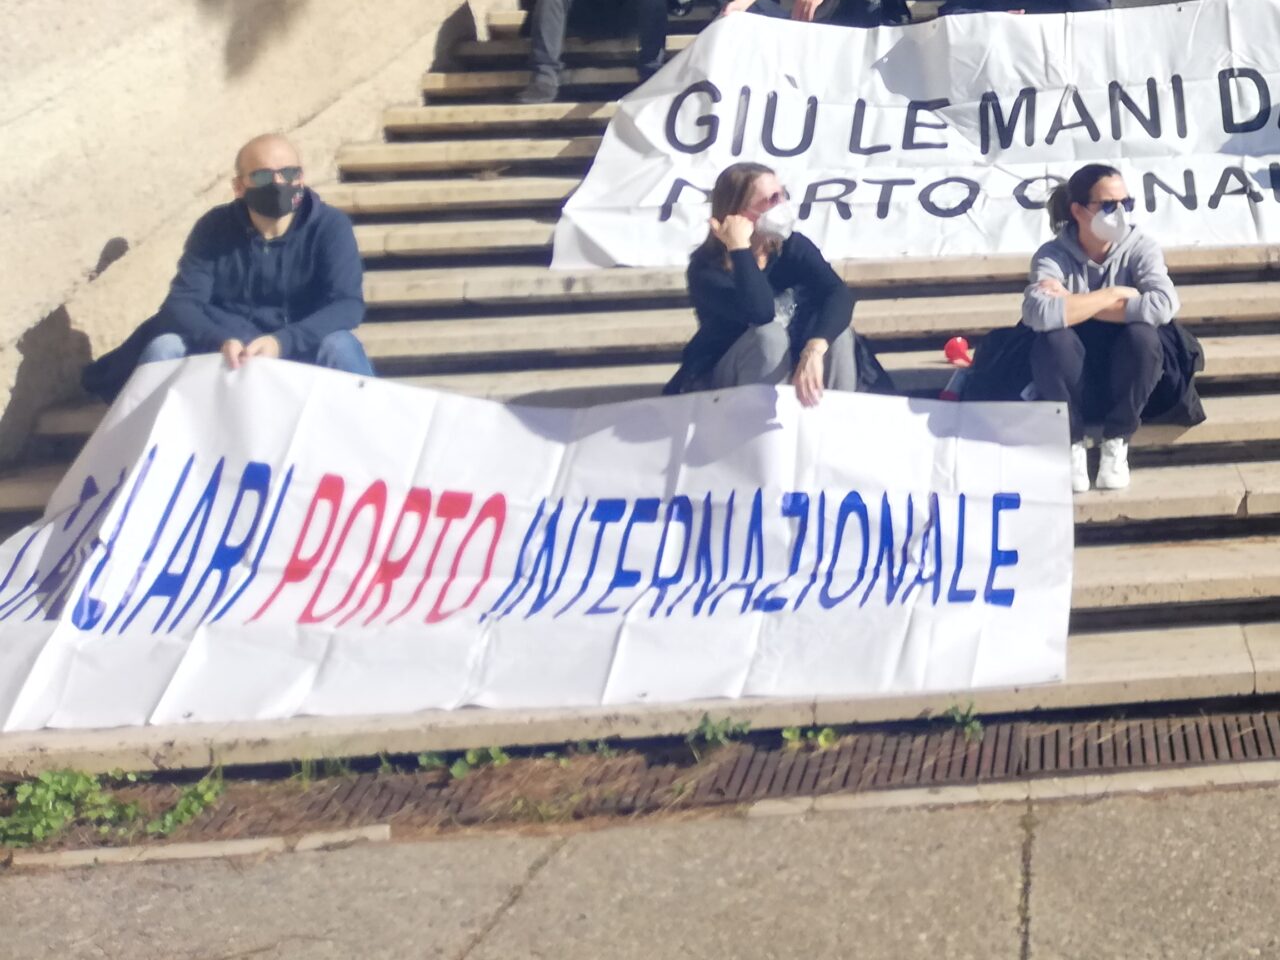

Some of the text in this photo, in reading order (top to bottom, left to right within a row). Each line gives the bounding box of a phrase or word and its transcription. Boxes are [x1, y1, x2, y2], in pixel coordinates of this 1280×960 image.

[665, 73, 818, 158] GIÙ
[849, 99, 951, 156] LE
[979, 74, 1187, 155] MANI
[659, 177, 980, 222] PRTO
[243, 473, 507, 629] PORTO
[477, 487, 1021, 626] INTERNAZIONALE
